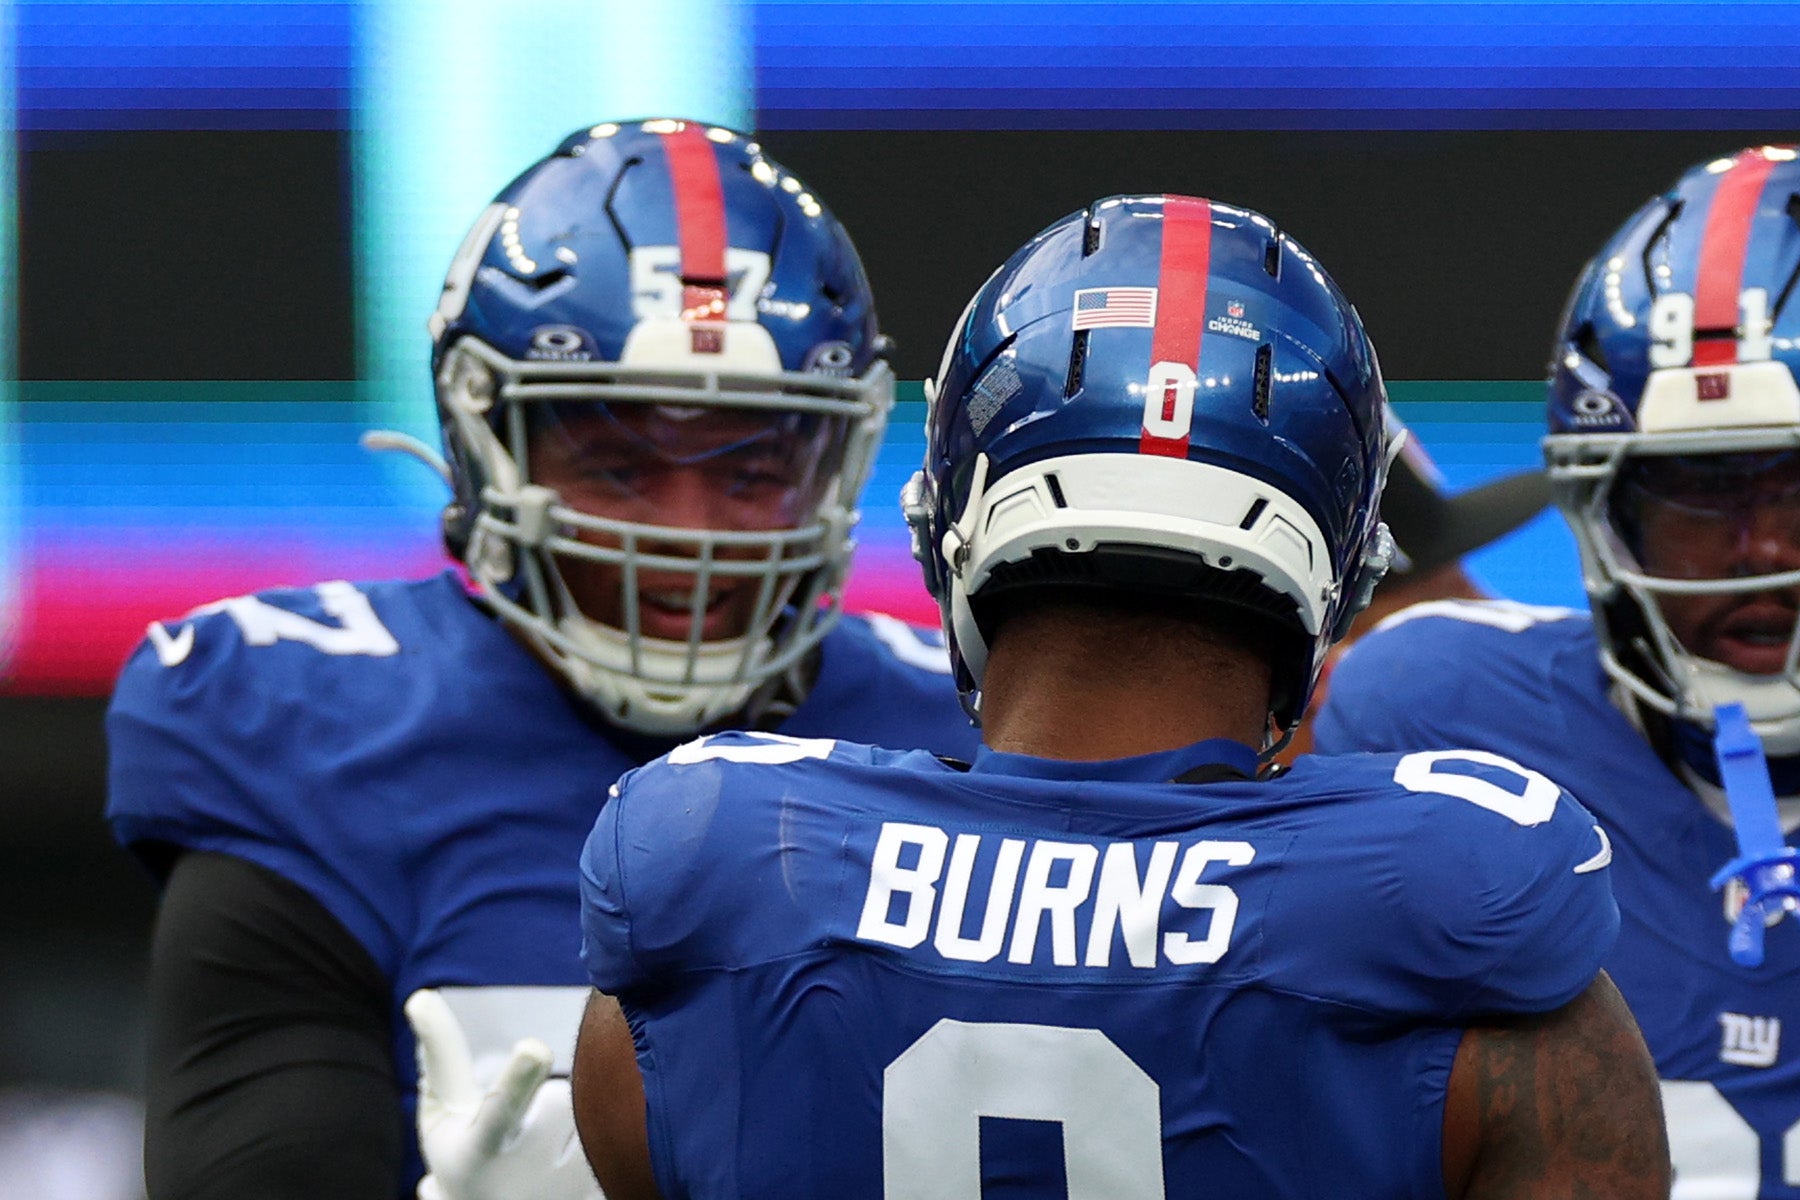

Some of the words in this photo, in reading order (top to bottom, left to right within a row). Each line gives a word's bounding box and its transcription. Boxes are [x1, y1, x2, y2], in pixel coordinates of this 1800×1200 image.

[630, 246, 772, 323] 57
[1208, 320, 1261, 341] CHANGE
[1649, 287, 1774, 368] 91
[1143, 360, 1197, 440] 0
[1393, 750, 1562, 828] 0
[857, 822, 1256, 968] BURNS
